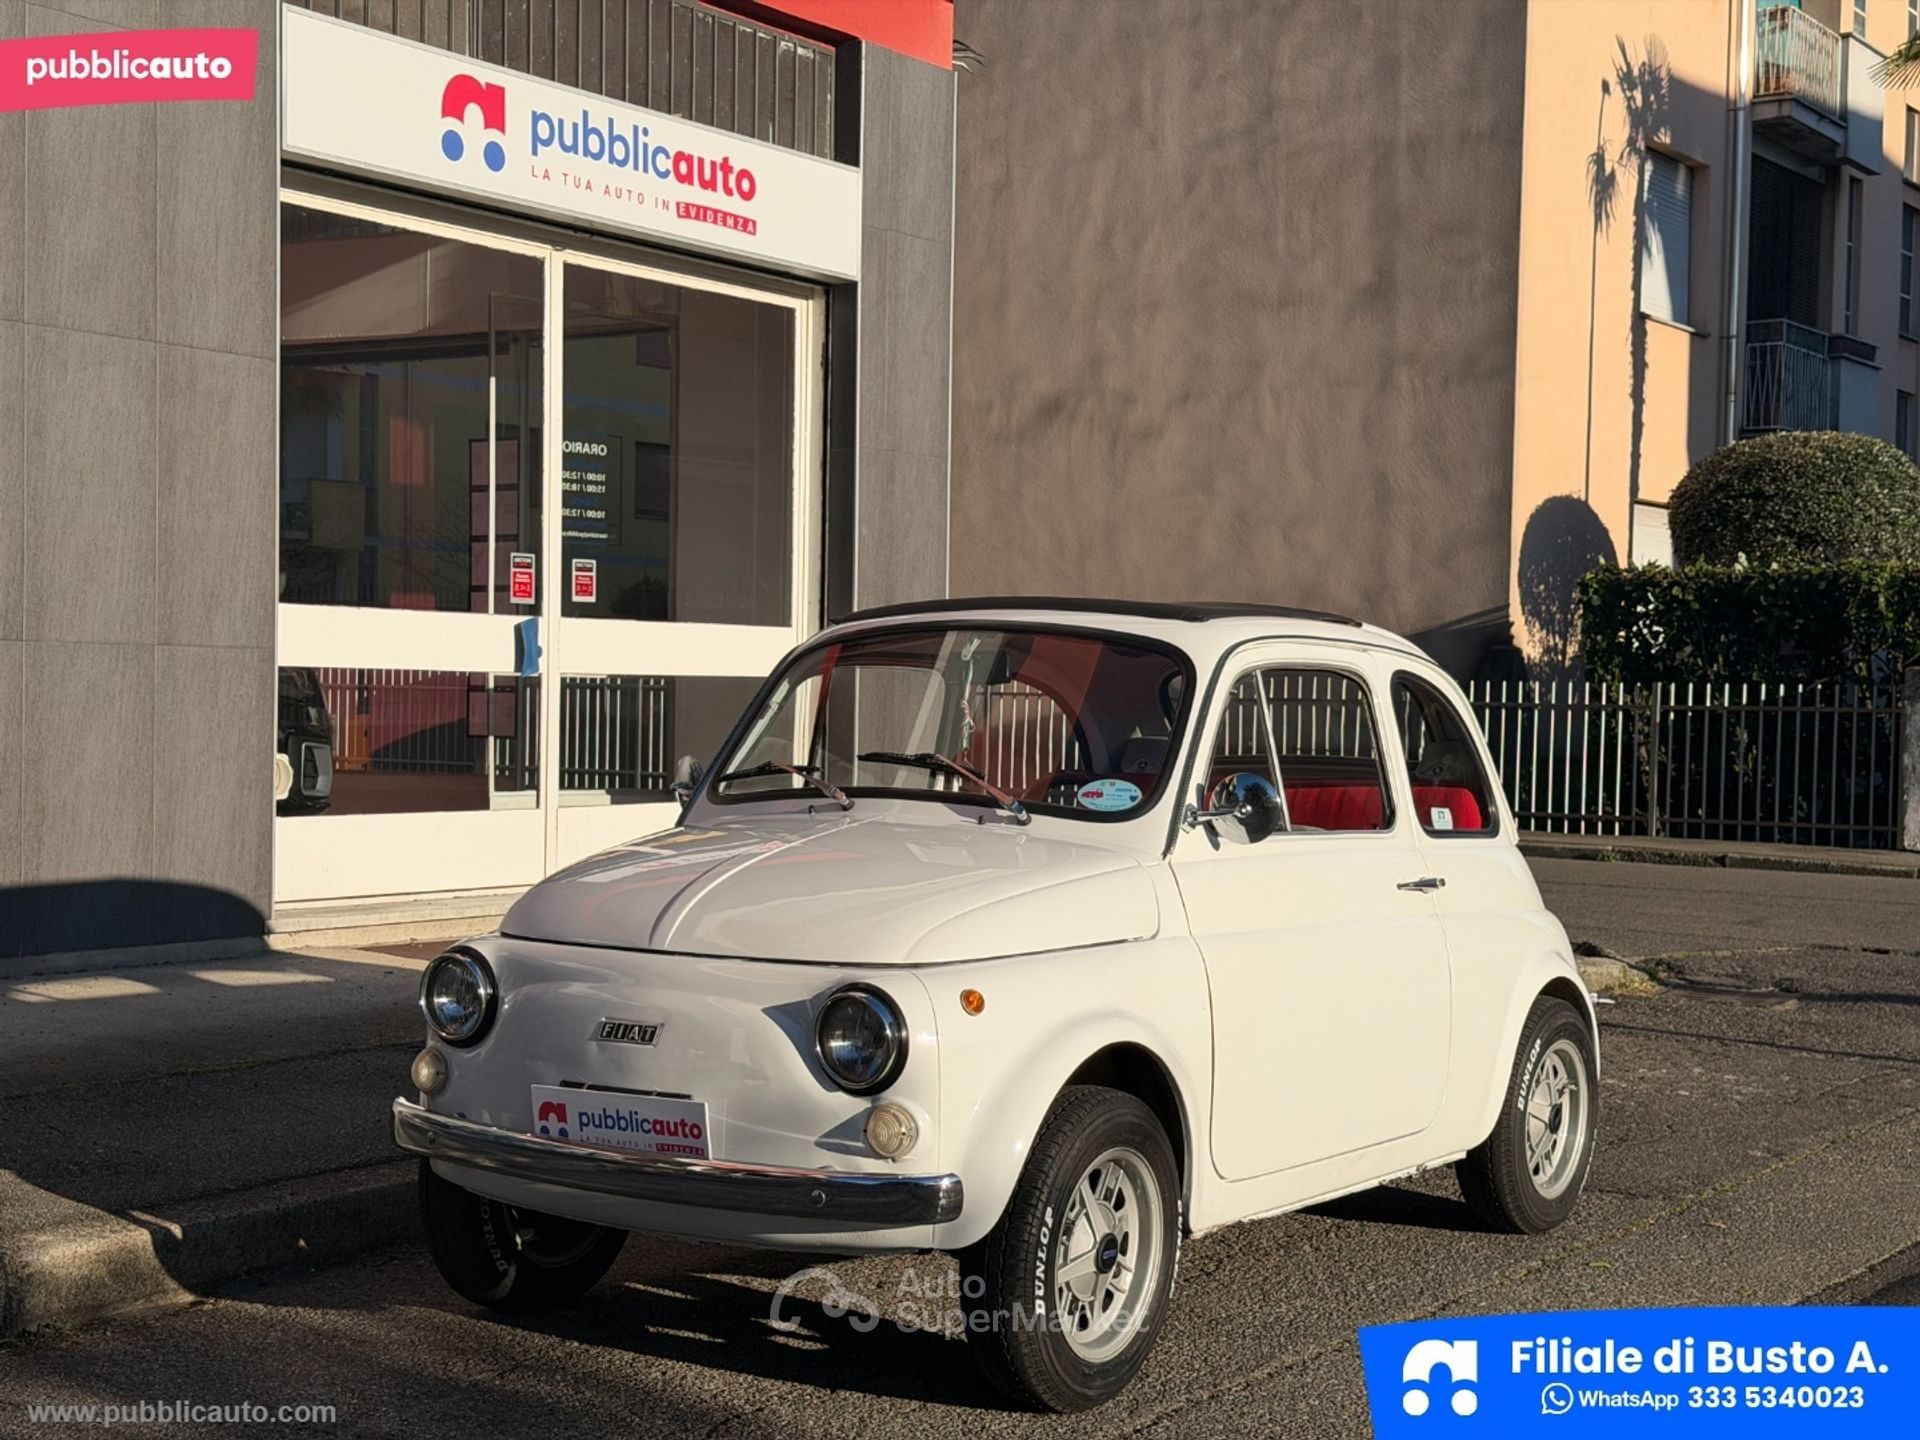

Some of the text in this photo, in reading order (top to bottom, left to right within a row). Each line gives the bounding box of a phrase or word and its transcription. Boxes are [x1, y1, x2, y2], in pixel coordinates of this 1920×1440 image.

[531, 109, 757, 201] pubblicauto
[531, 165, 758, 236] LA TUA AUTO IN EVIDENZA
[602, 1023, 655, 1041] FIAT
[1517, 1038, 1541, 1112] DUNLOP
[578, 1107, 703, 1140] pubblicauto
[1035, 1205, 1055, 1317] DUNLOP
